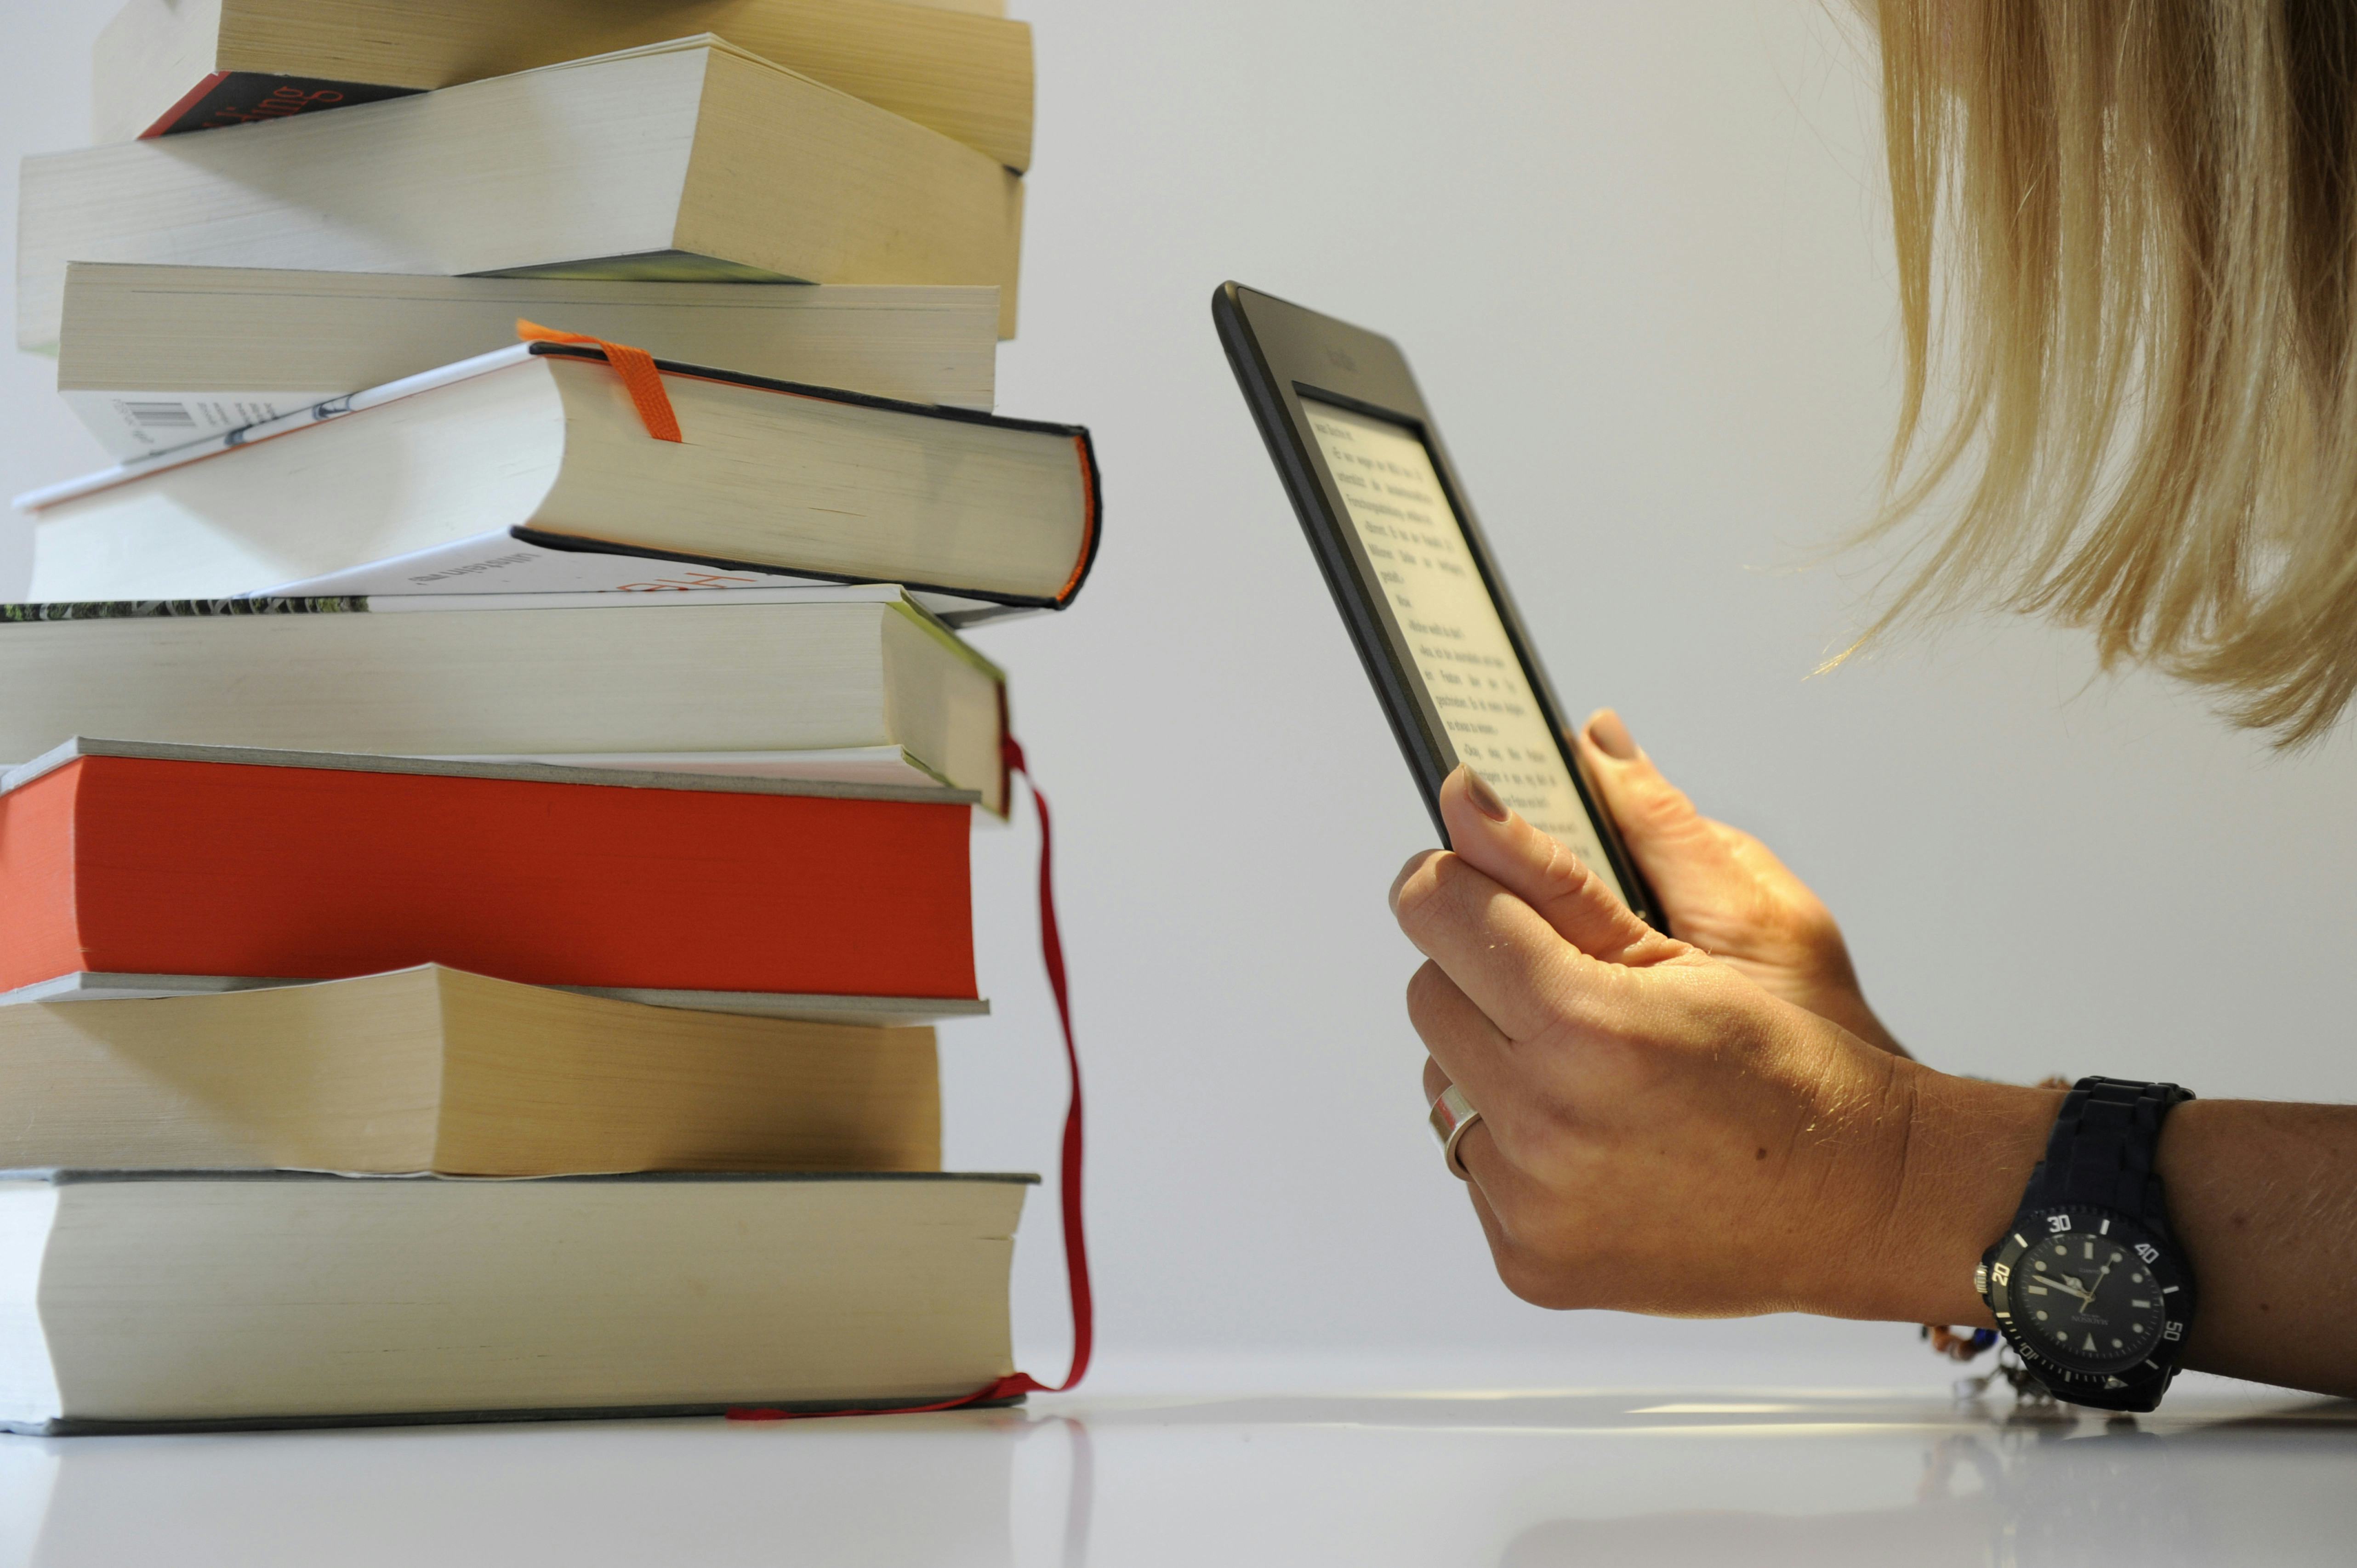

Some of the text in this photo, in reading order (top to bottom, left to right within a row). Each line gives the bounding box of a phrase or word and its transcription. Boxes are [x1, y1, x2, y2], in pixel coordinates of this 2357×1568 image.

[2047, 1215, 2071, 1232] 30
[2134, 1243, 2159, 1263] 40
[1992, 1262, 2010, 1286] 20
[2071, 1316, 2109, 1326] MADISON
[2163, 1320, 2183, 1341] 50
[2020, 1345, 2037, 1360] 10
